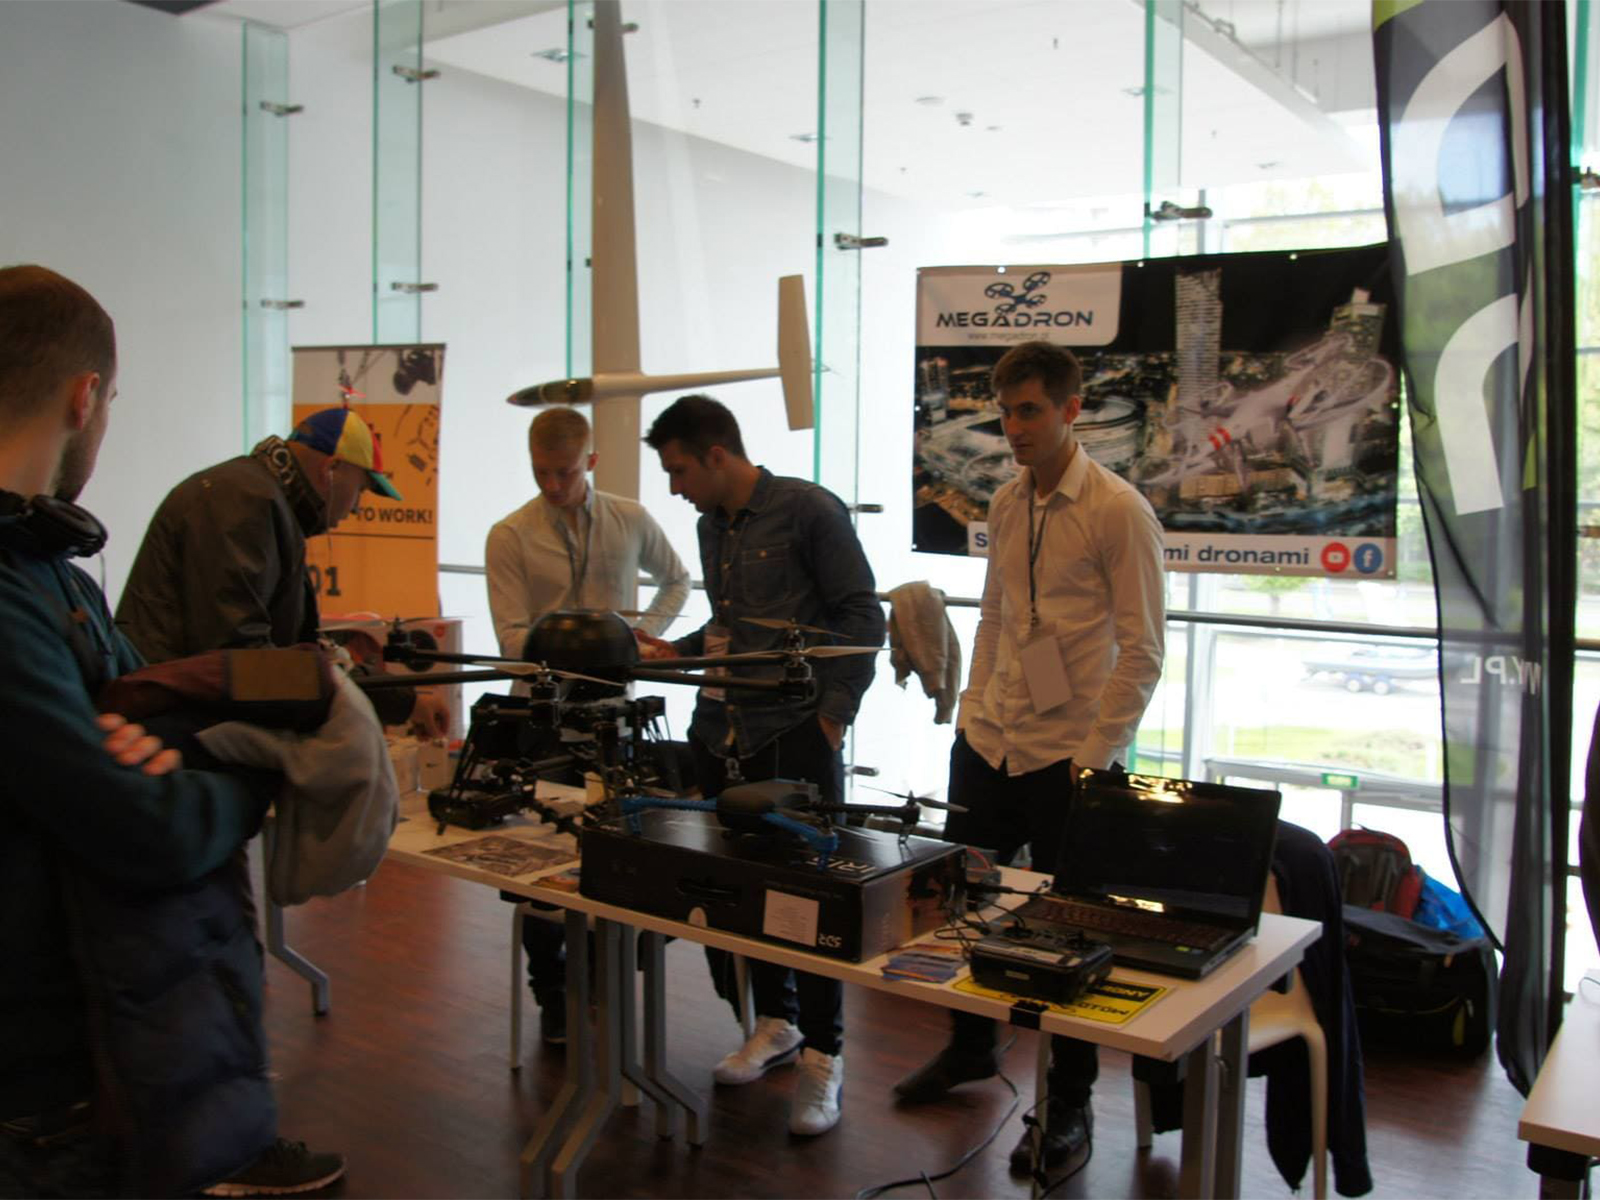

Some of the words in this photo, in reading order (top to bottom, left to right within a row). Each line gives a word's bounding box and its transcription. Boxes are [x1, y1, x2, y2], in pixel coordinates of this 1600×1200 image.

[936, 310, 1093, 328] MEGADRON
[379, 508, 433, 524] WORK!
[1197, 545, 1309, 565] dronami
